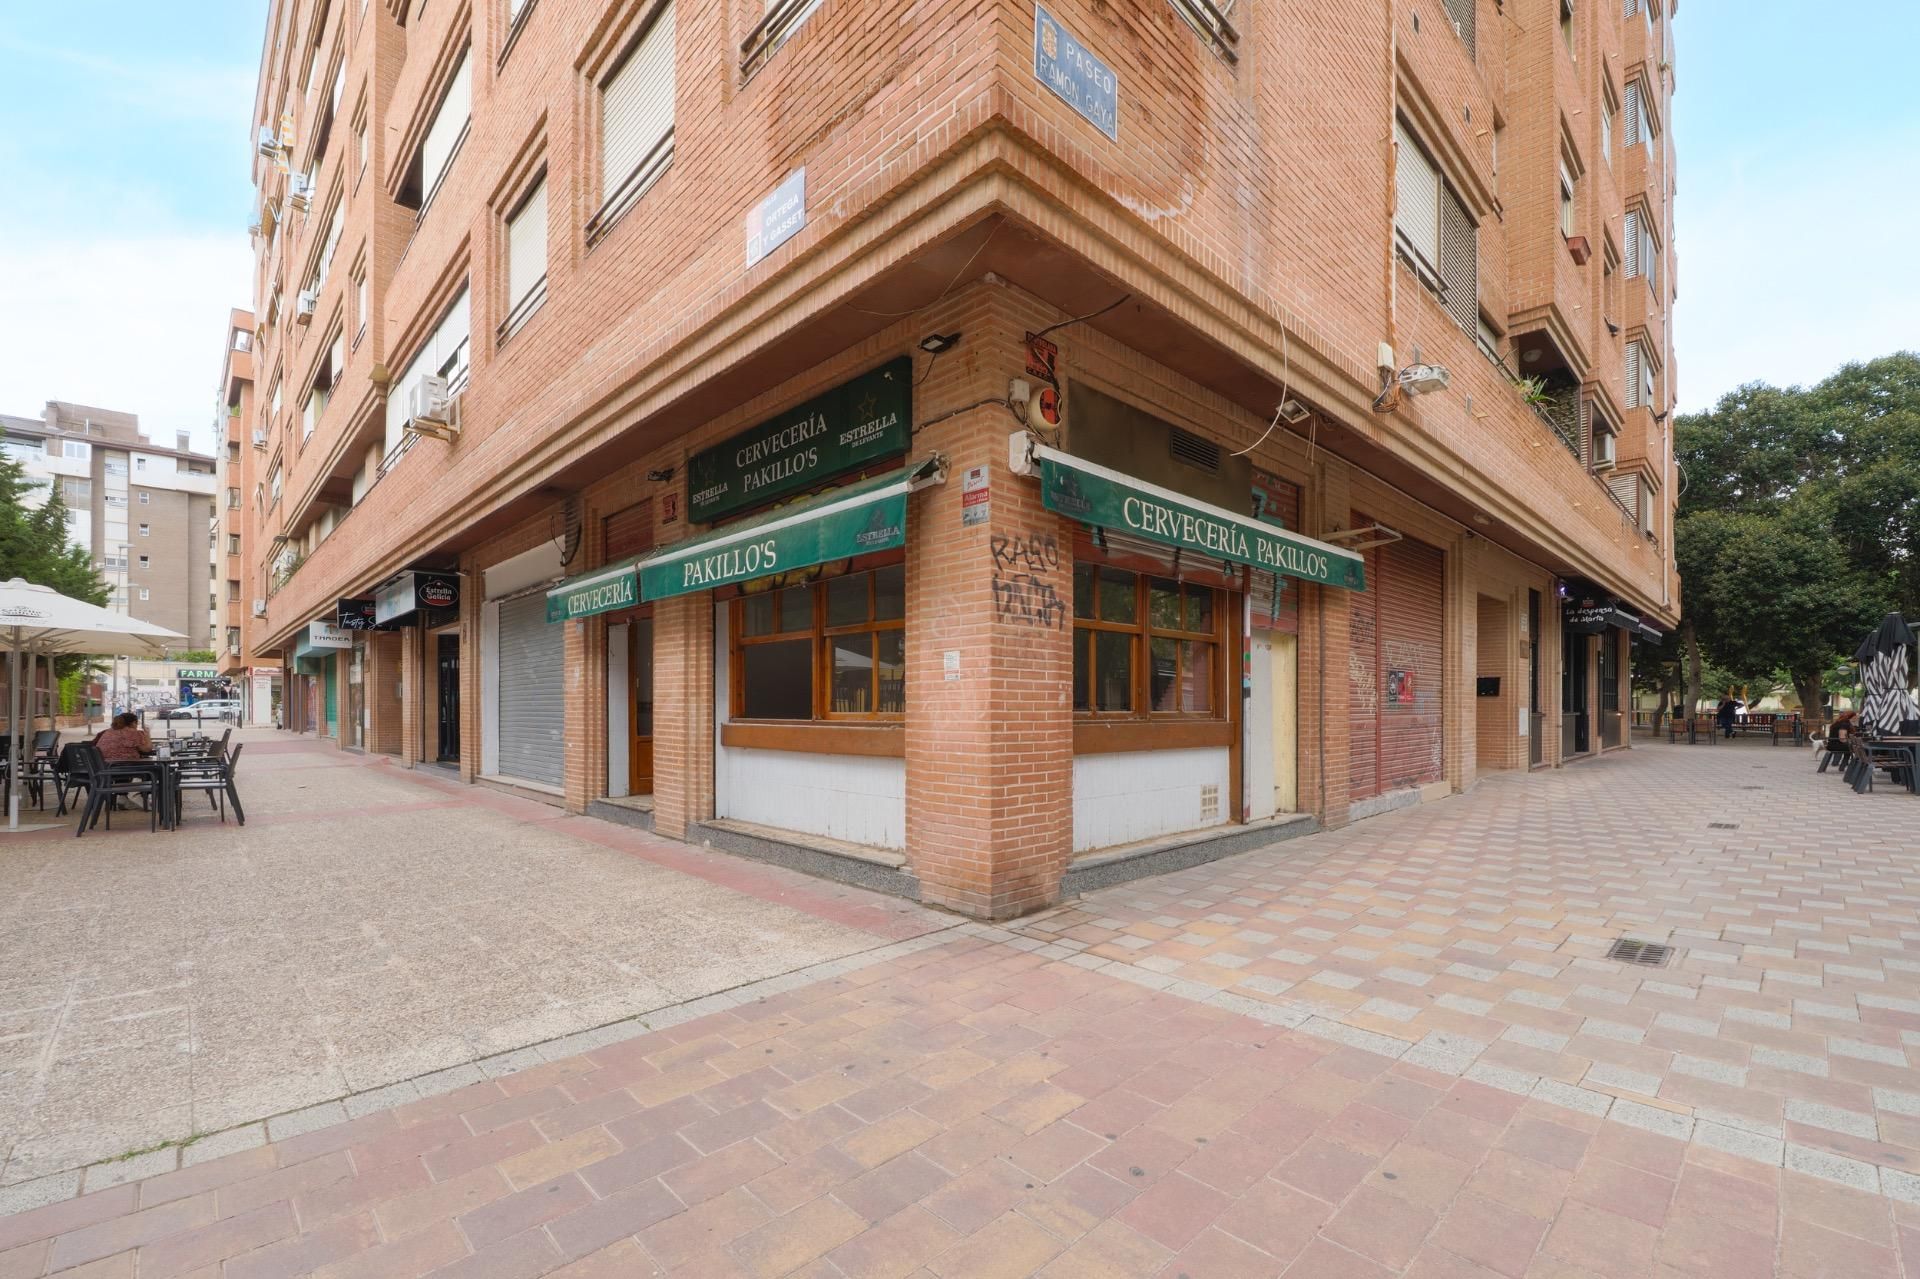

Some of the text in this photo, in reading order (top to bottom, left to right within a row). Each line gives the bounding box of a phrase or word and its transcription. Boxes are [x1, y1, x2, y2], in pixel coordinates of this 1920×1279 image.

[1066, 42, 1111, 94] PASEO
[1040, 54, 1115, 132] RAMON GAYA
[763, 209, 803, 247] Y GASSET
[766, 193, 799, 226] ORTEGA
[736, 412, 828, 468] CERVECERÍA
[839, 412, 897, 446] ESTRELLA
[860, 430, 884, 445] LEVANTE
[743, 447, 818, 493] PAKILLO'S
[692, 482, 728, 504] ESTRELLA
[1123, 496, 1250, 559] CERVECERÍA
[1256, 537, 1328, 579] PAKILLO'S
[426, 586, 452, 595] Estrella
[567, 540, 777, 615] CERVECERÍA PAKILLO'S
[1577, 606, 1613, 616] despensa
